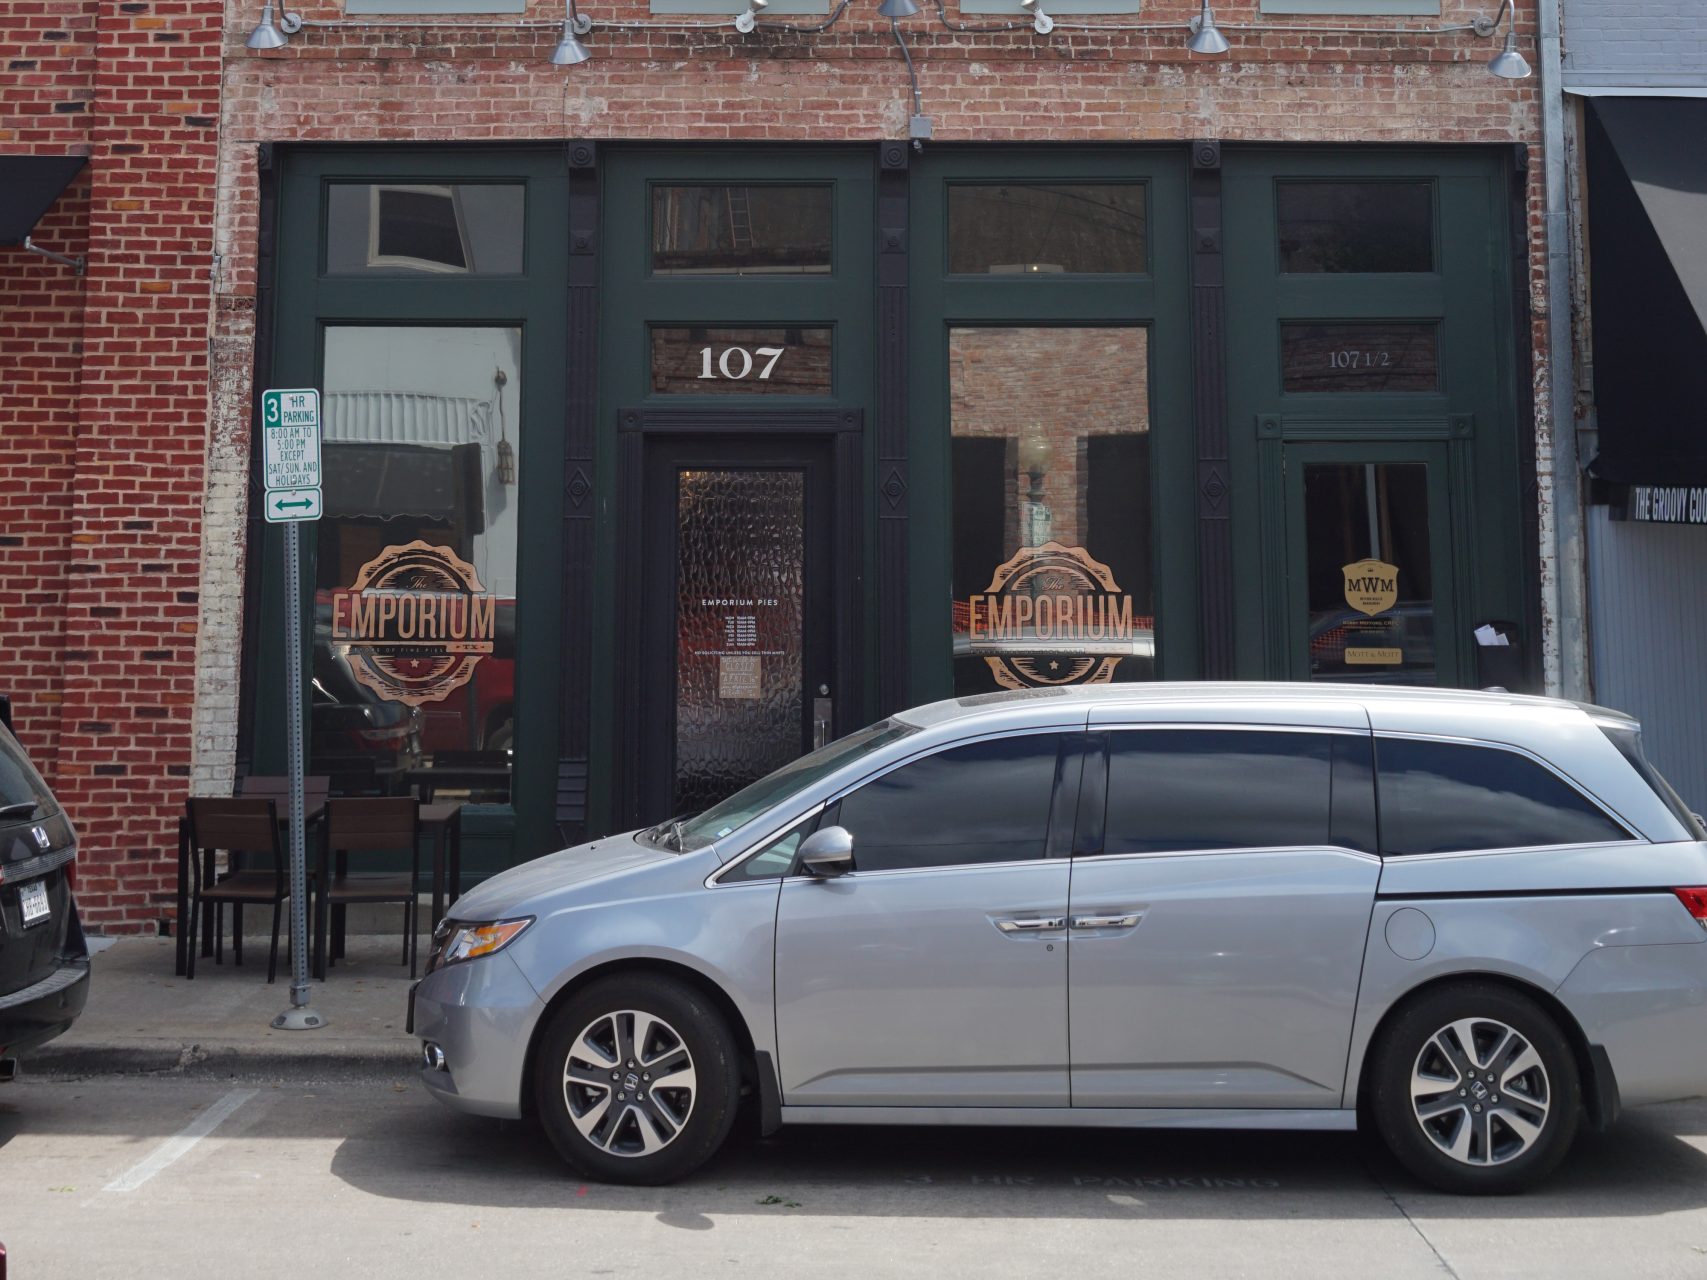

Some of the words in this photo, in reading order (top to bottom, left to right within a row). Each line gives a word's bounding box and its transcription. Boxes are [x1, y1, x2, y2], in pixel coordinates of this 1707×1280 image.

[698, 347, 784, 379] 107
[1328, 351, 1360, 368] 107
[1364, 352, 1391, 367] 1/2
[267, 398, 278, 422] 3
[292, 396, 305, 408] HR
[284, 410, 314, 423] PARKING
[271, 428, 287, 439] 8:00
[290, 428, 300, 438] AM
[302, 428, 311, 437] TO
[277, 440, 294, 450] 5:00
[296, 439, 305, 449] PM
[280, 450, 304, 461] EXCEPT
[303, 462, 317, 472] AND
[276, 474, 310, 486] HOLIDAYS
[1636, 488, 1650, 520] THE
[1652, 488, 1688, 522] GROOVY
[406, 576, 427, 589] The
[1041, 576, 1064, 590] The
[1348, 577, 1394, 594] MWM
[332, 594, 496, 639] EMPORIUM
[969, 595, 1133, 641] EMPORIUM
[972, 1175, 1035, 1185] HR
[1072, 1175, 1280, 1188] PARKING
